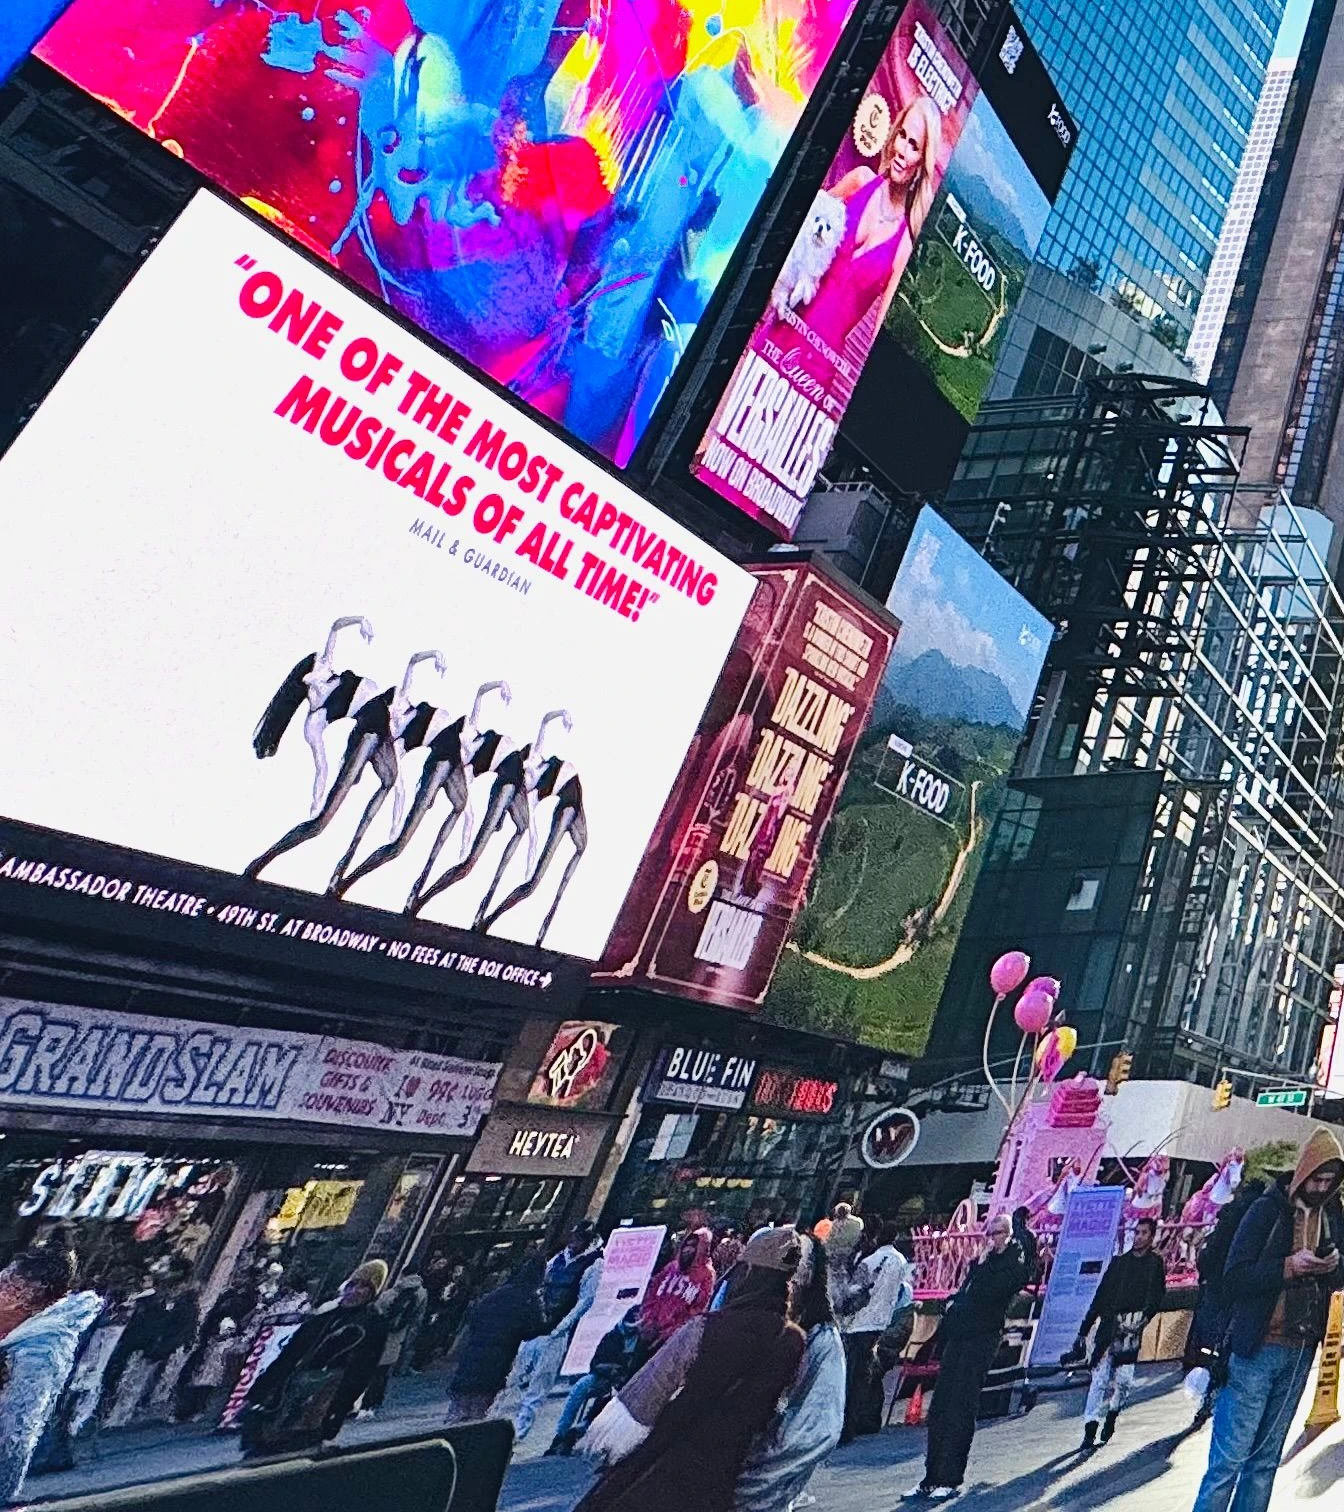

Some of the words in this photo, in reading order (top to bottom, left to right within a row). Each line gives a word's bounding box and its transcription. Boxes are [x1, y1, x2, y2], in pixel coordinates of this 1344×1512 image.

[952, 223, 996, 291] K-FOOD
[760, 339, 784, 365] THE
[780, 347, 825, 403] Queen
[716, 347, 835, 500] VERSAILLES
[275, 376, 477, 519] MUSICALS
[472, 492, 524, 545] OF
[515, 528, 575, 578] ALL
[337, 336, 402, 400] OF
[397, 370, 473, 445] THE
[466, 414, 562, 504] MOST
[557, 481, 720, 607] CAPTIVATING
[700, 436, 735, 479] NOW
[727, 455, 751, 491] ON
[742, 466, 804, 530] BROADWAY
[409, 520, 446, 552] MAIL
[463, 548, 533, 596] GUARDIAN
[895, 759, 950, 814] K-FOOD
[0, 856, 130, 901] AMBASSADOR
[131, 884, 205, 918] THEATRE
[217, 904, 257, 928] 49TH
[257, 912, 279, 934] ST.
[280, 917, 302, 938] AT
[301, 921, 378, 955] BROADWAY
[388, 940, 410, 958] NO
[411, 943, 440, 965] FEES
[440, 951, 458, 969] AT
[457, 953, 478, 973] THE
[477, 958, 502, 980] BOX
[502, 963, 541, 987] OFFICE
[319, 1070, 362, 1090] GIFTS
[667, 1047, 722, 1083] BLUE
[721, 1055, 757, 1088] FIN
[379, 1100, 415, 1127] NY
[508, 1129, 575, 1159] HEYTEA
